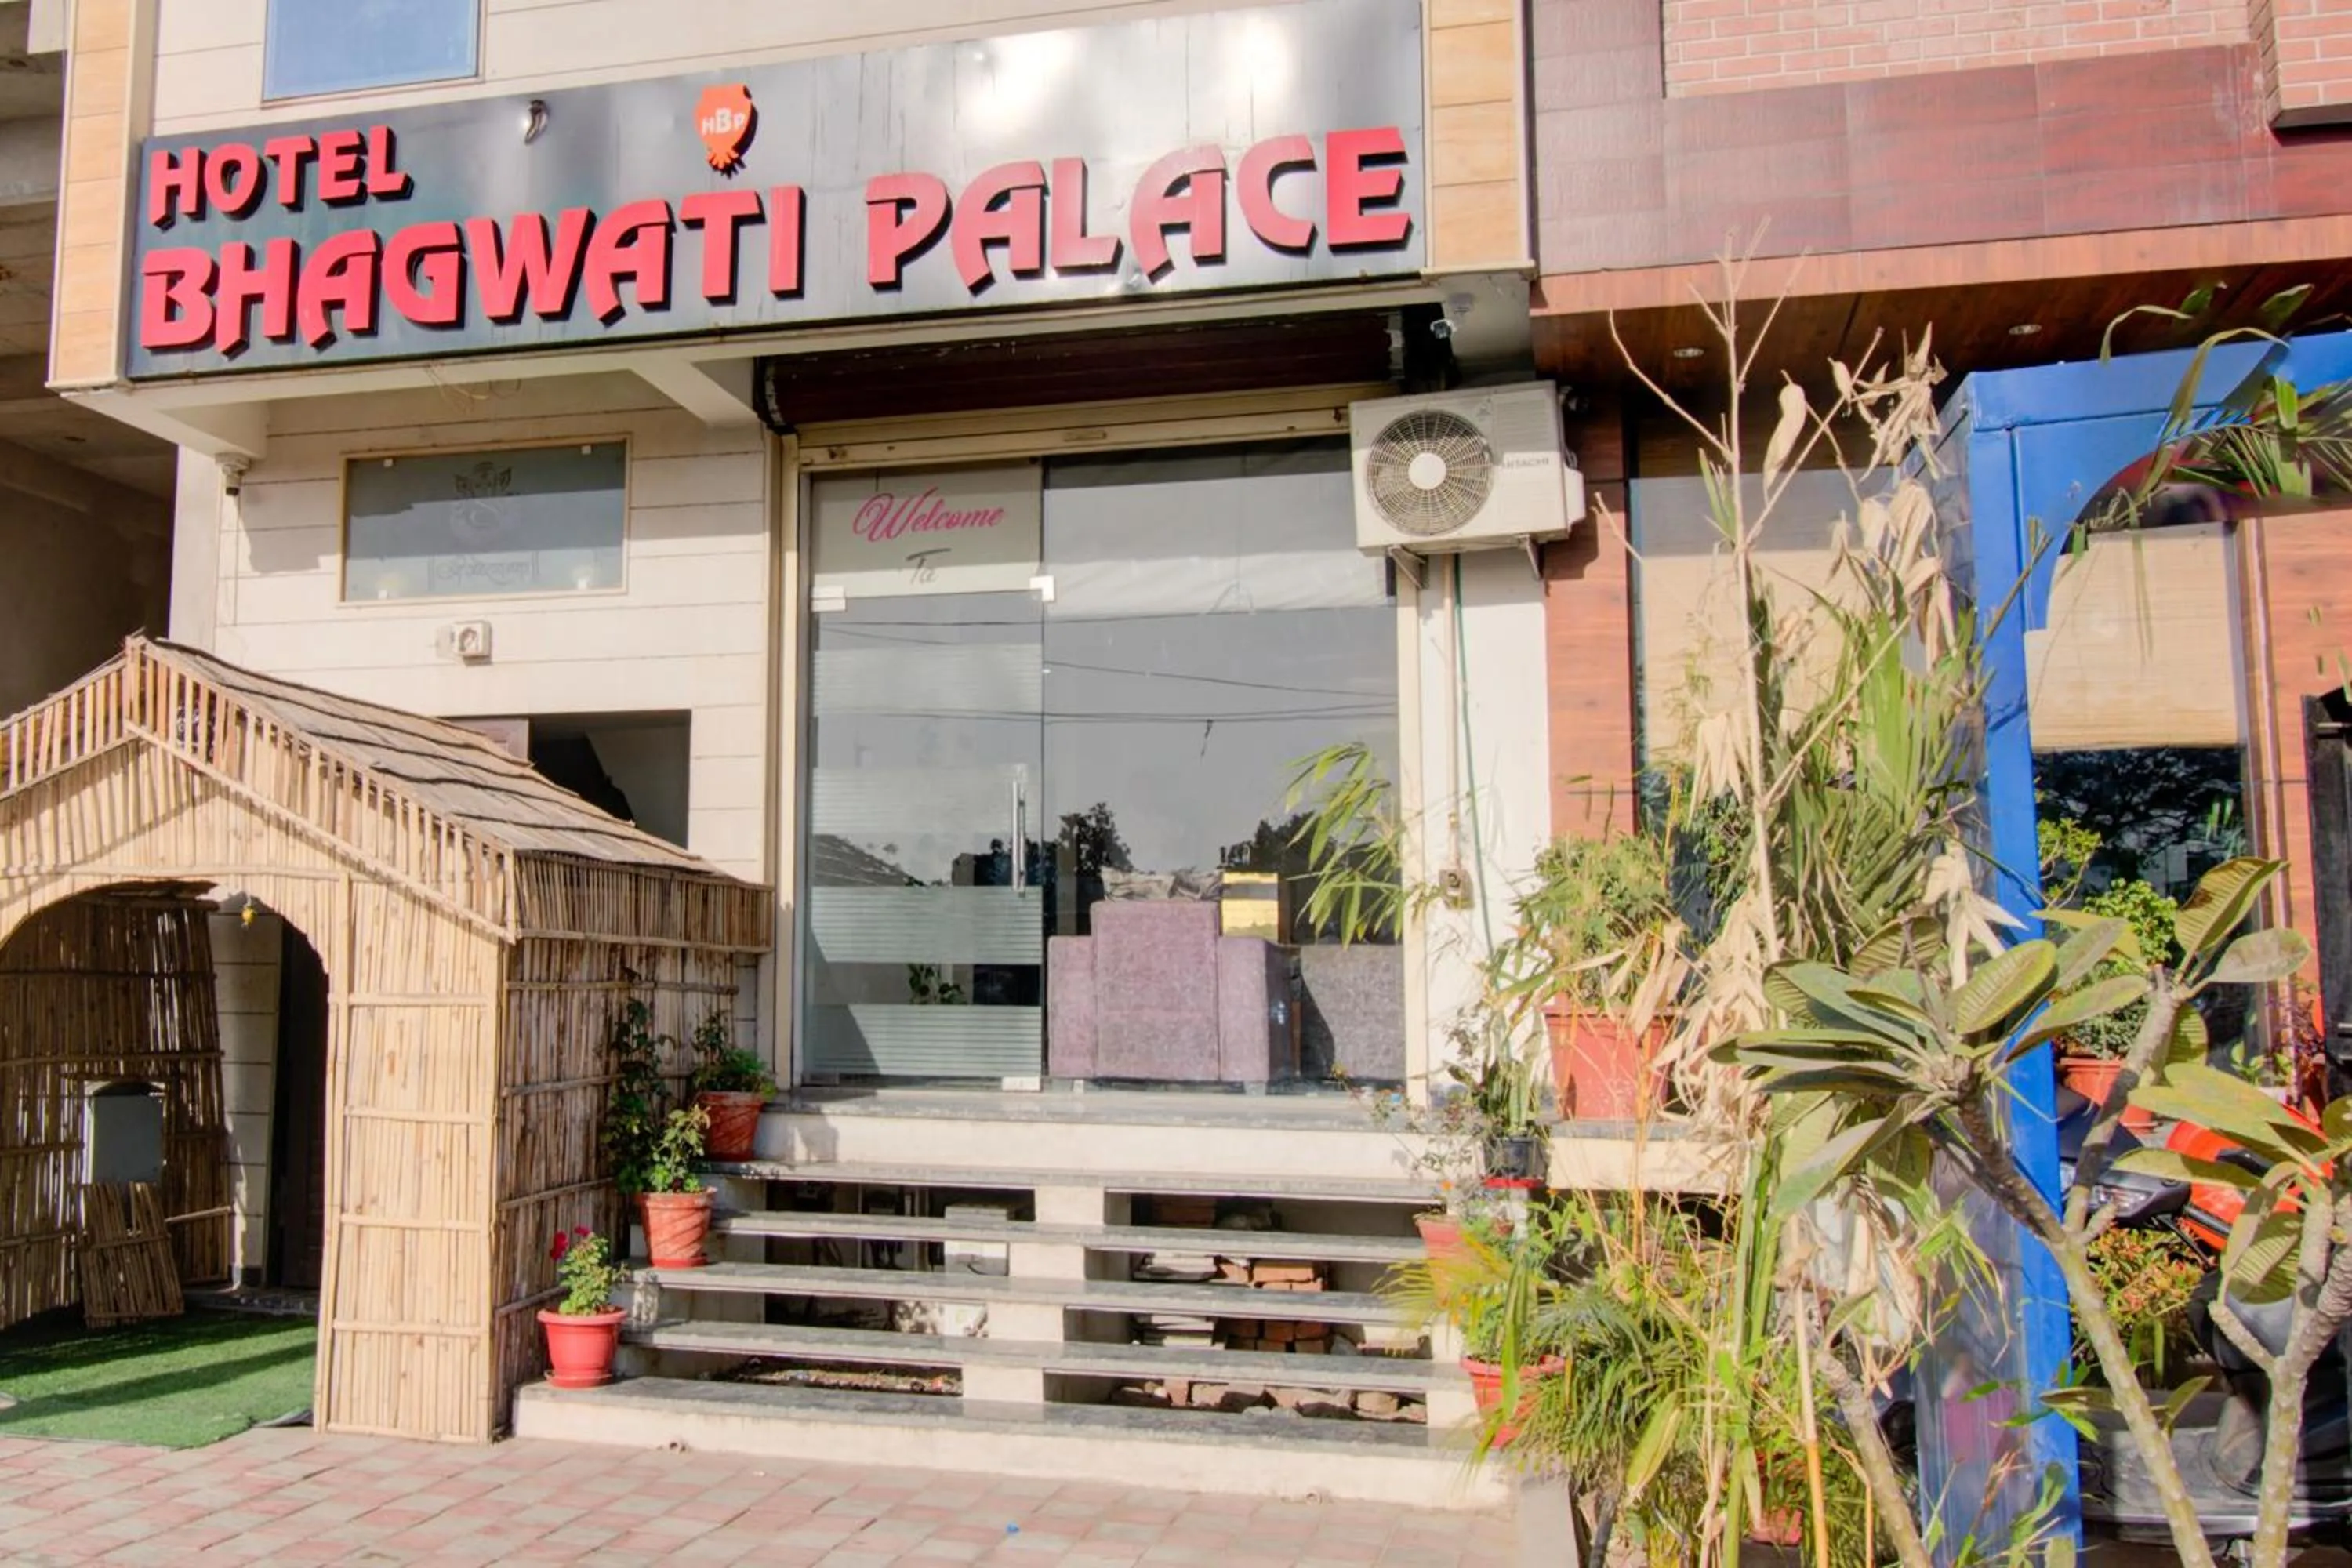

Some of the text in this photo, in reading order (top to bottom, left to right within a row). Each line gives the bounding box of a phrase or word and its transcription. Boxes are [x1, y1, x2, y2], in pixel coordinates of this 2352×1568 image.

[702, 107, 746, 136] HBP
[148, 125, 412, 229] HOTEL
[140, 126, 1410, 357] BHAGWATI PALACE
[851, 485, 1006, 542] Welcome
